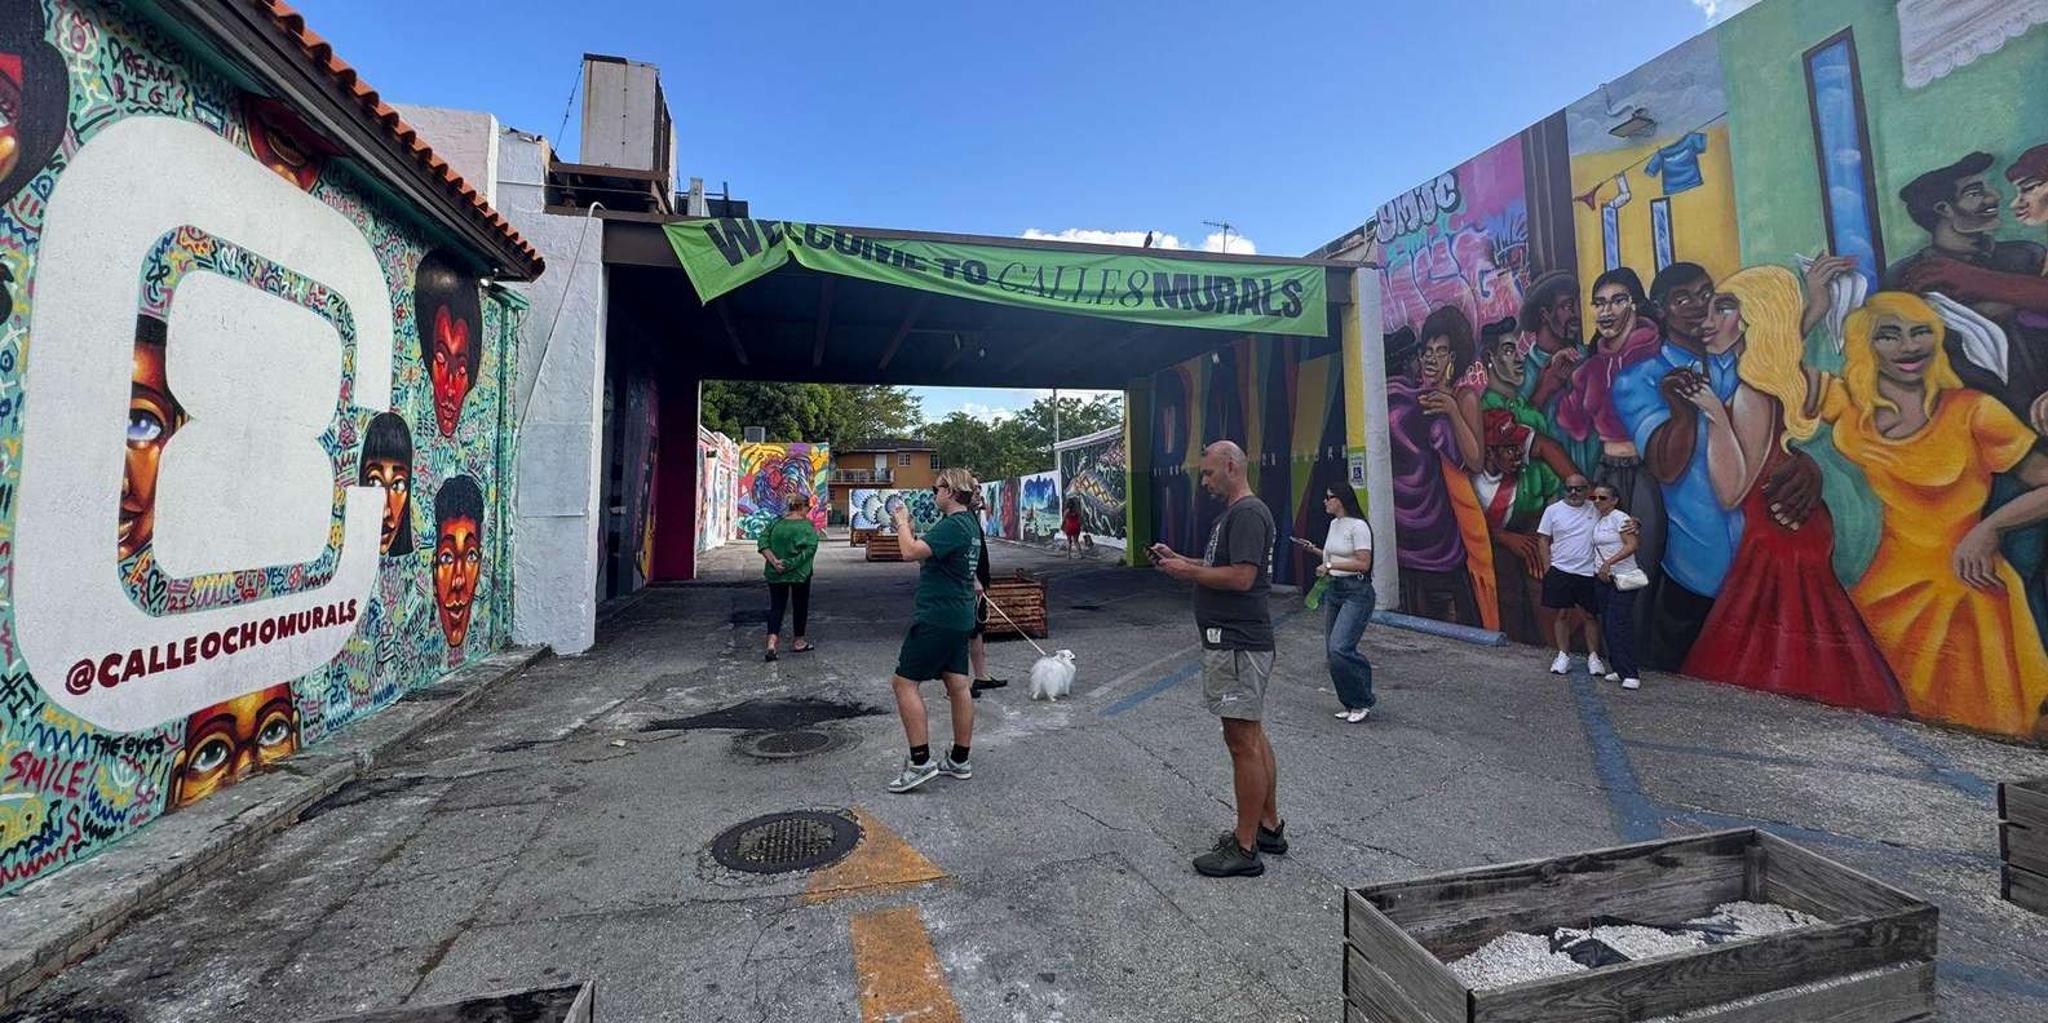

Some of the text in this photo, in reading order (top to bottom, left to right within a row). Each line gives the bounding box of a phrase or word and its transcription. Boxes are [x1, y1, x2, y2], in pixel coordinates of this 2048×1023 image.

[107, 36, 177, 88] DREAM
[111, 73, 171, 106] BIG!
[933, 257, 989, 285] TO
[1151, 271, 1304, 319] MURALS
[65, 598, 357, 695] @CALLEOCHOMURALS
[90, 732, 127, 757] THE
[4, 750, 99, 798] SMILE!
